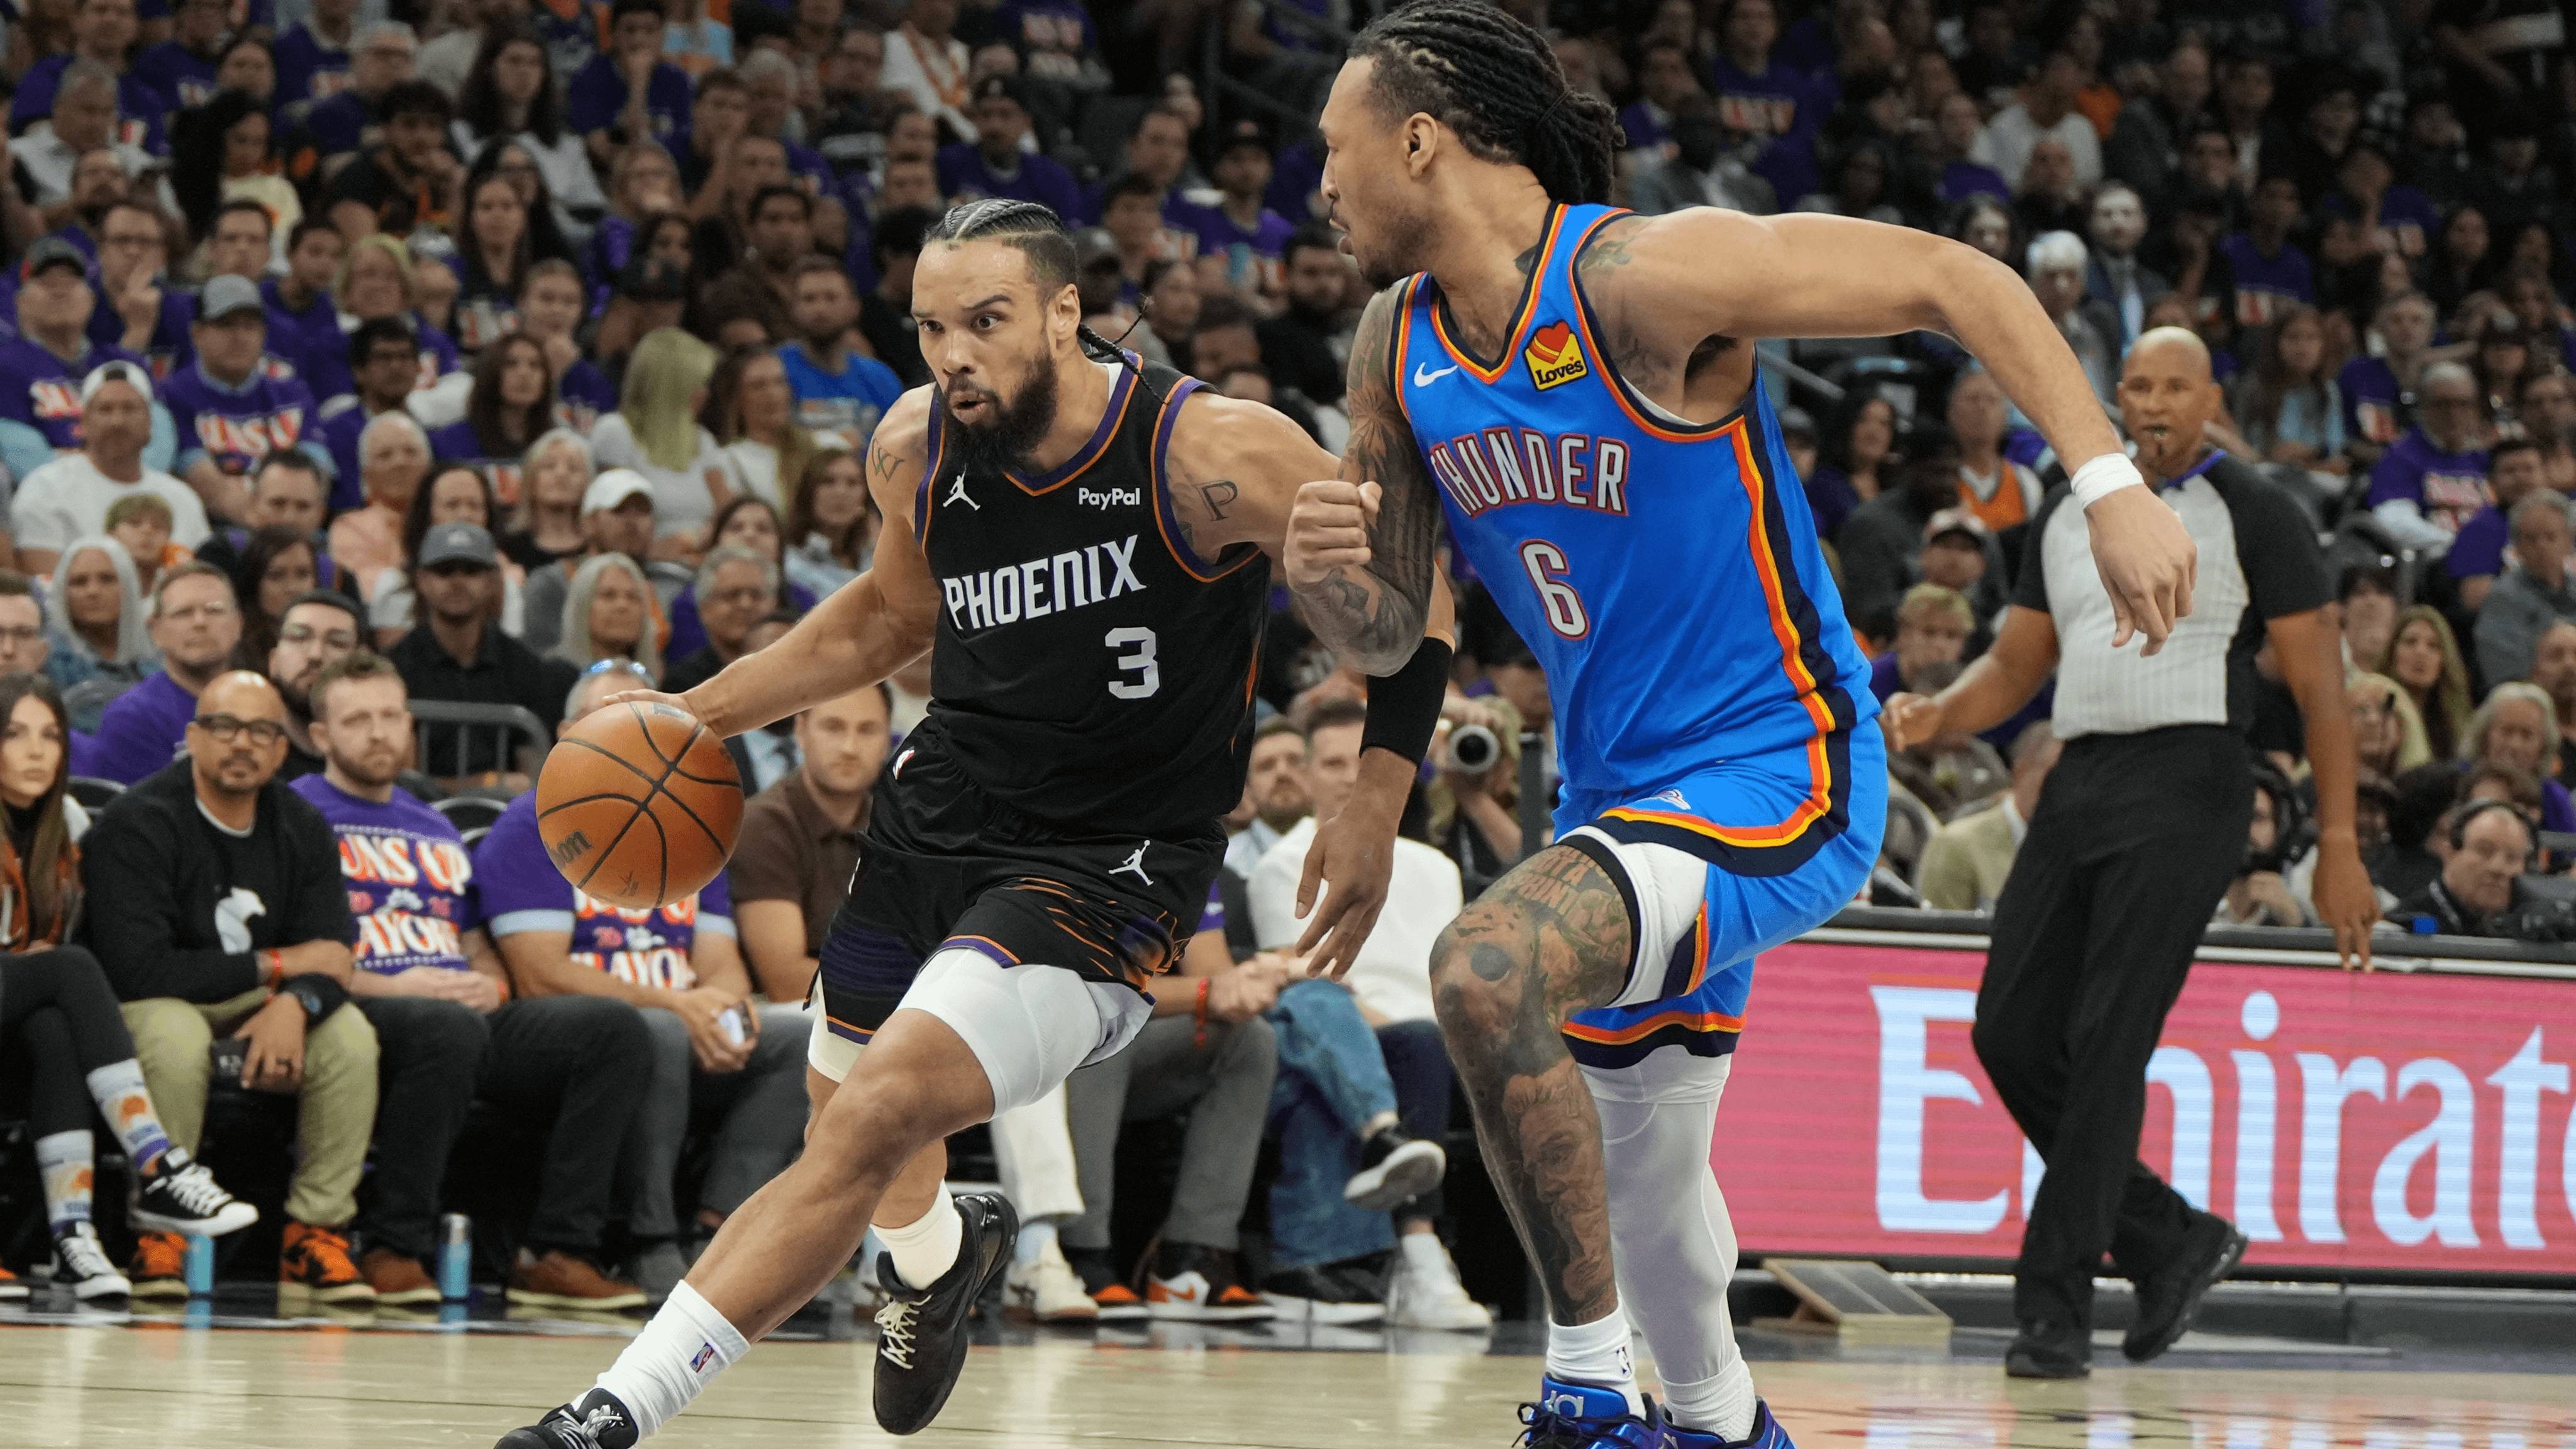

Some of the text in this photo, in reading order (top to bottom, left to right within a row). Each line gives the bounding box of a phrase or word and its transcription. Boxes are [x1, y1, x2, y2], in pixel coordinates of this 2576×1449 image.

[1079, 487, 1140, 510] PayPal
[1192, 480, 1238, 521] P
[942, 534, 1148, 630] PHOENIX
[1519, 539, 1590, 640] 6
[1105, 626, 1160, 699] 3
[1869, 986, 2576, 1249] Eirat
